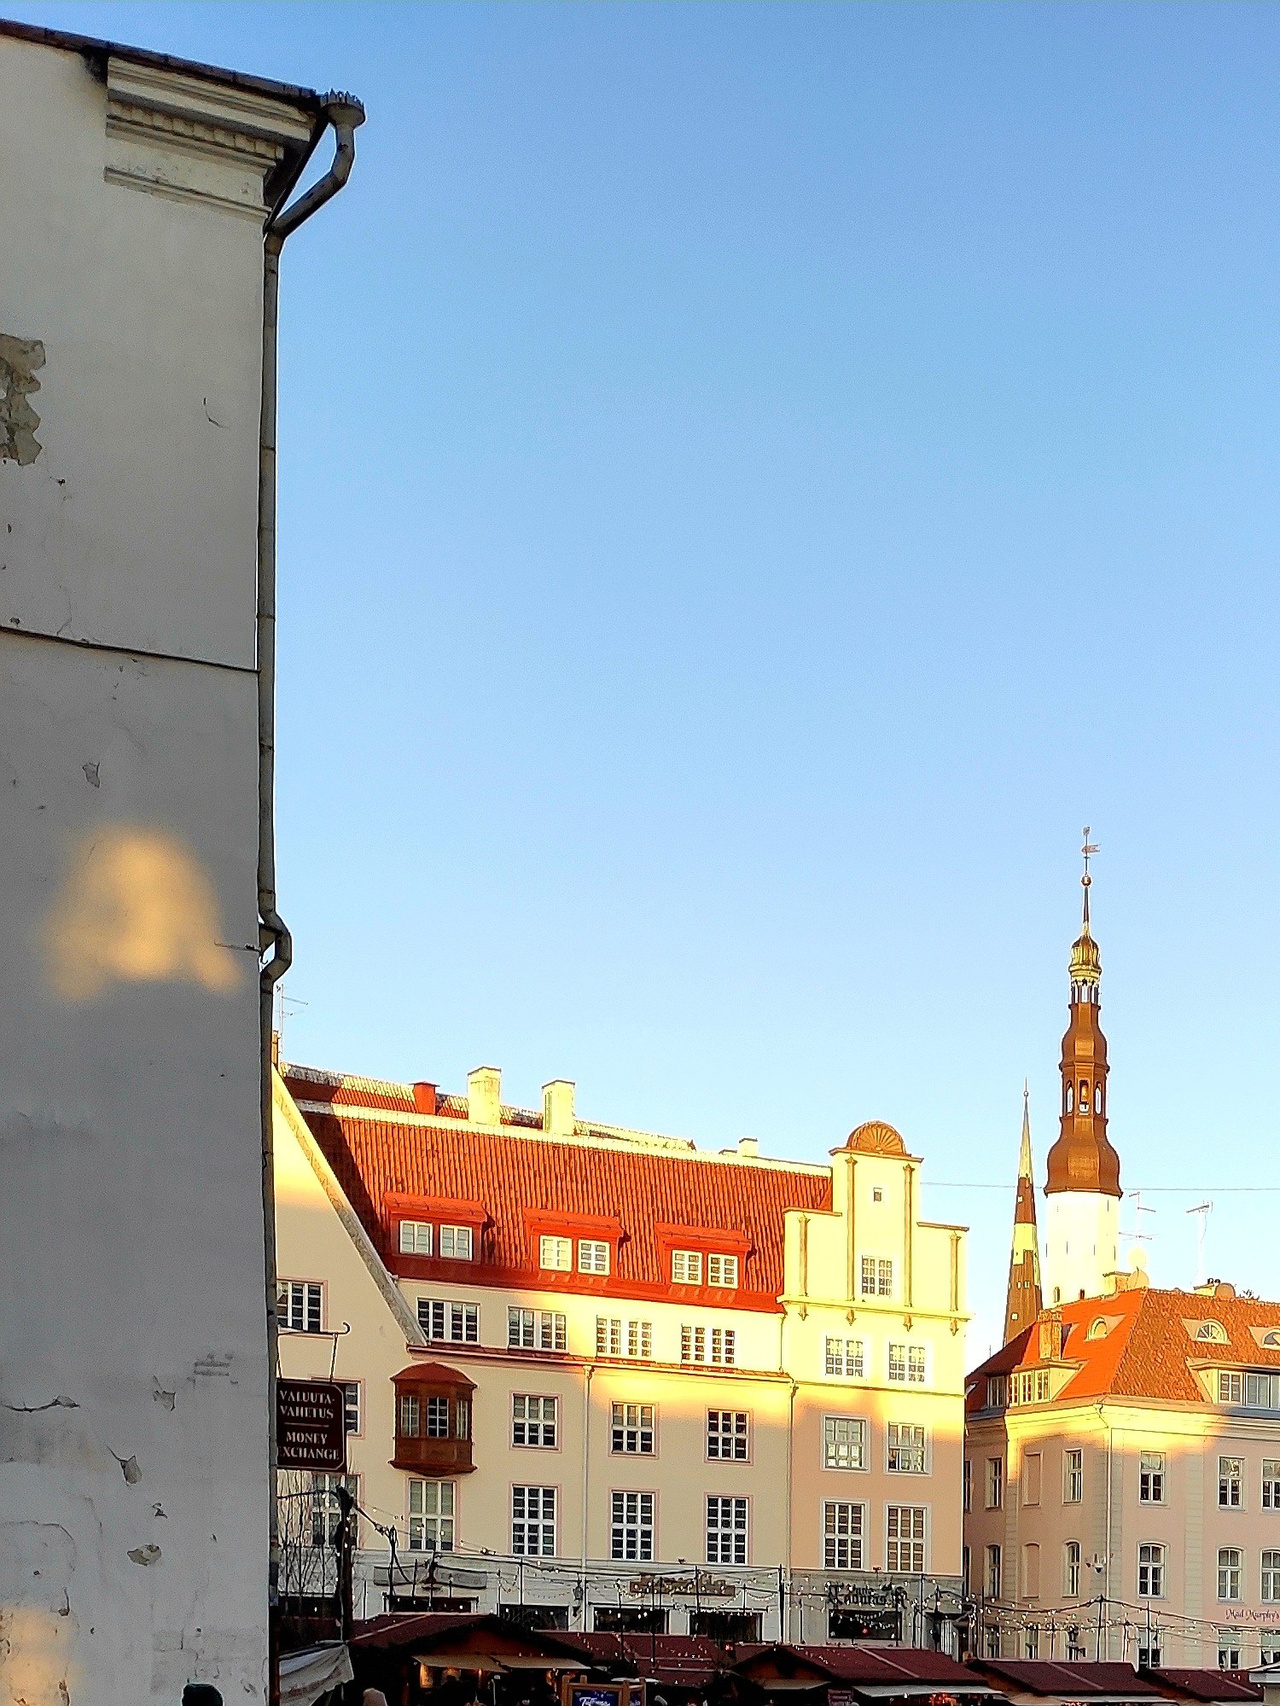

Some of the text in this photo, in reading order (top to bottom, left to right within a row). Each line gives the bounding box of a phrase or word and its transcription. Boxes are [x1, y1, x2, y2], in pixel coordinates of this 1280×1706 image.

[280, 1405, 334, 1419] VAHETUS
[286, 1432, 327, 1445] MONEY
[1225, 1608, 1279, 1622] Mad Murphy's
